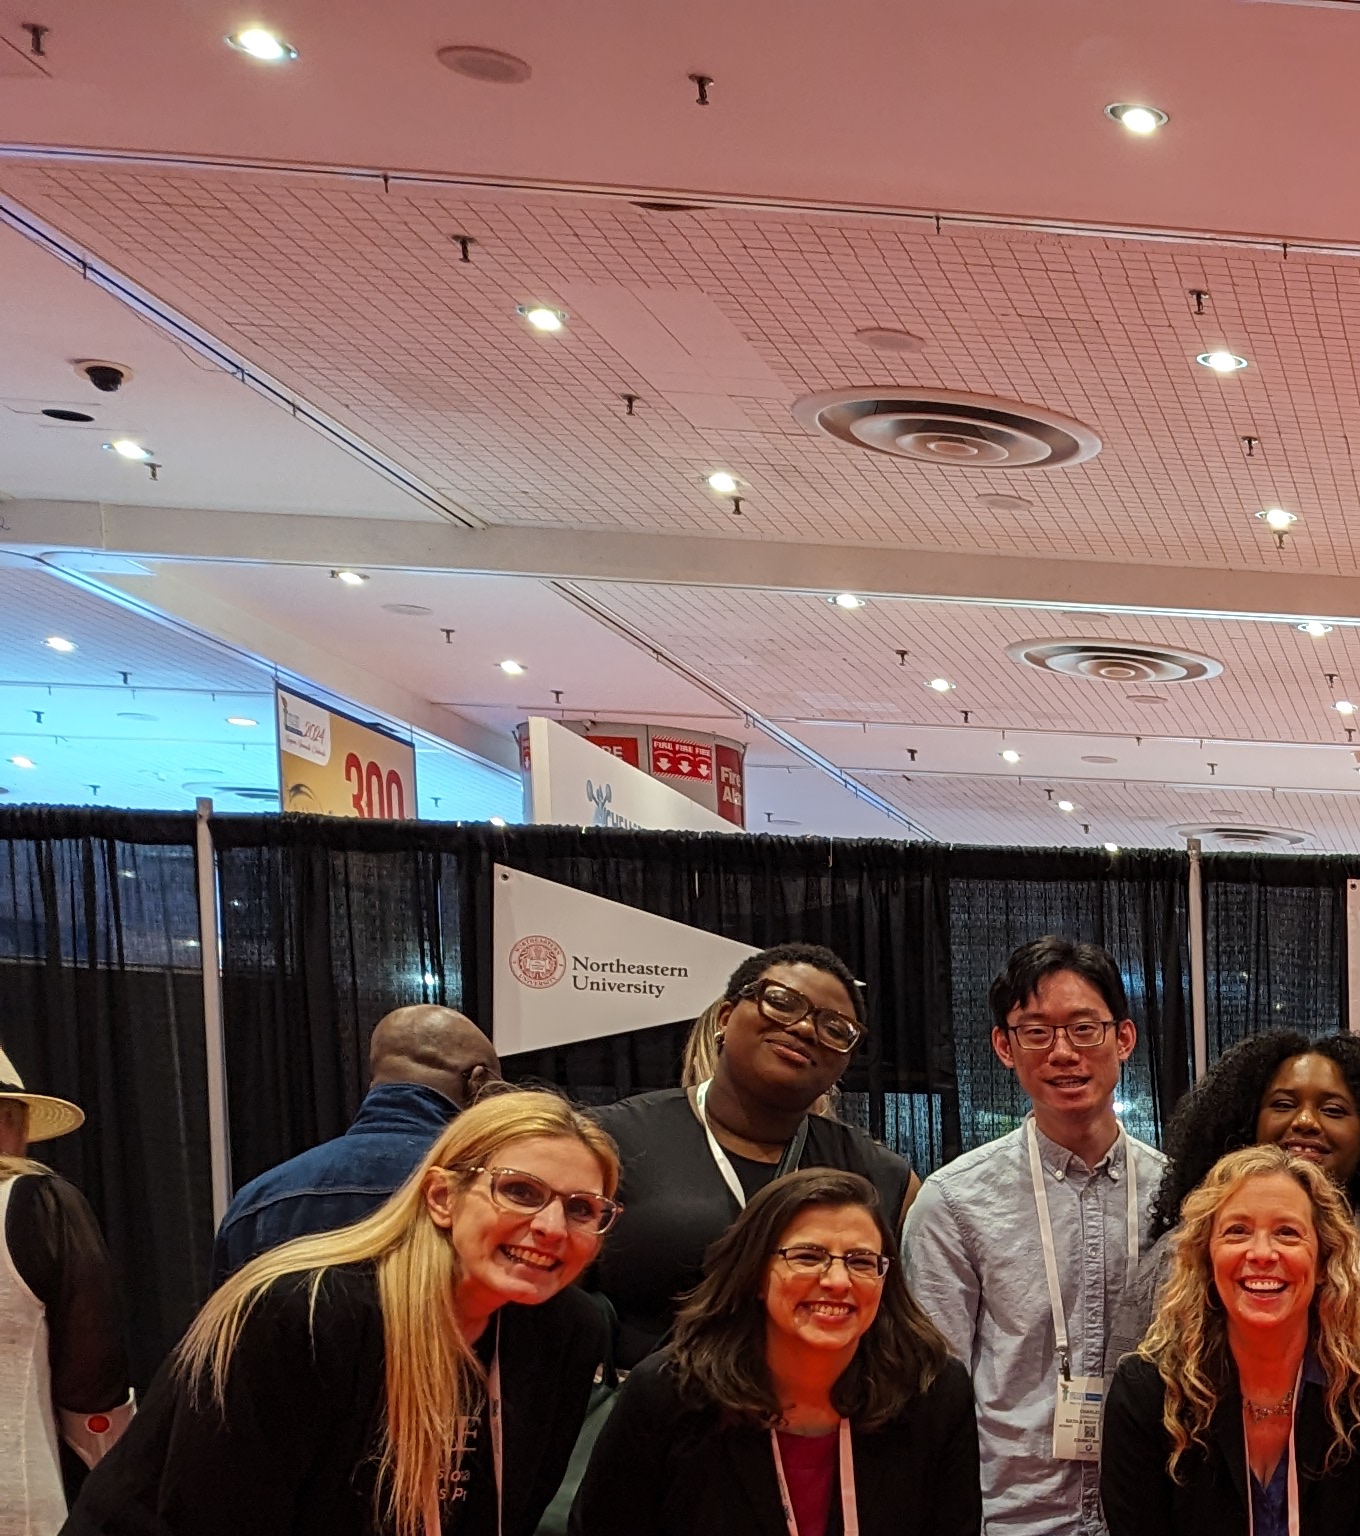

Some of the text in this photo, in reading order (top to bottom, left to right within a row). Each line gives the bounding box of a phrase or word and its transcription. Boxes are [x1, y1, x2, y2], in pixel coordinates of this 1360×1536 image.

[654, 741, 711, 757] FIRE FIRE FIRE
[345, 752, 405, 819] 300
[723, 786, 742, 806] Ala
[572, 956, 689, 978] Northeastern
[572, 975, 665, 998] University
